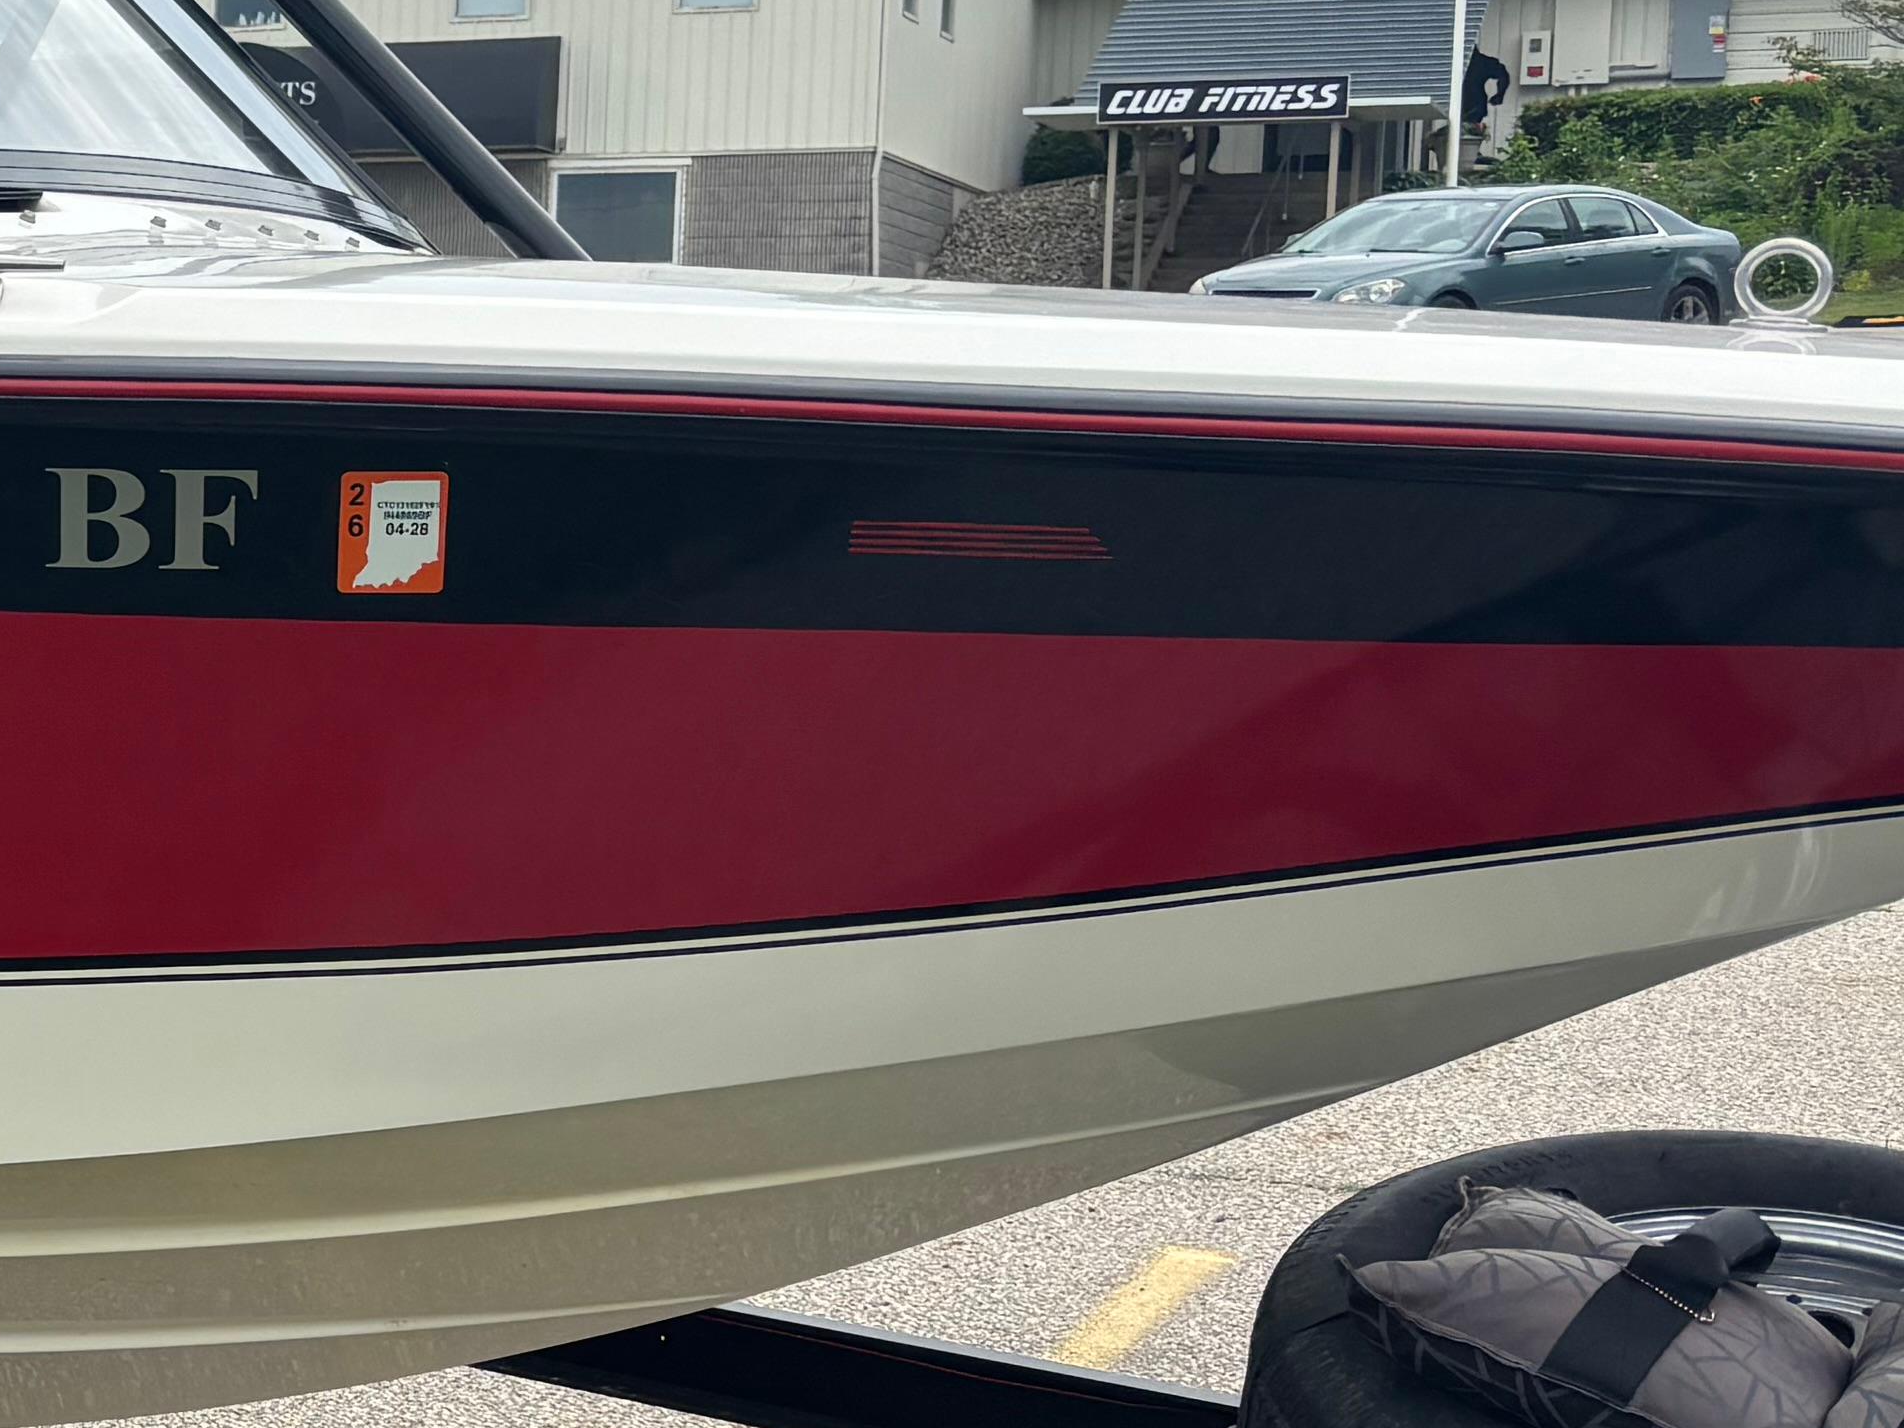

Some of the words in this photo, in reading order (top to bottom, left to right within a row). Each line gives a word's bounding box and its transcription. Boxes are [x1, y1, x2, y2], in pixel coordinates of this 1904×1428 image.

[1106, 88, 1194, 116] CLUB
[1198, 83, 1341, 113] FITNESS
[43, 466, 259, 571] BF
